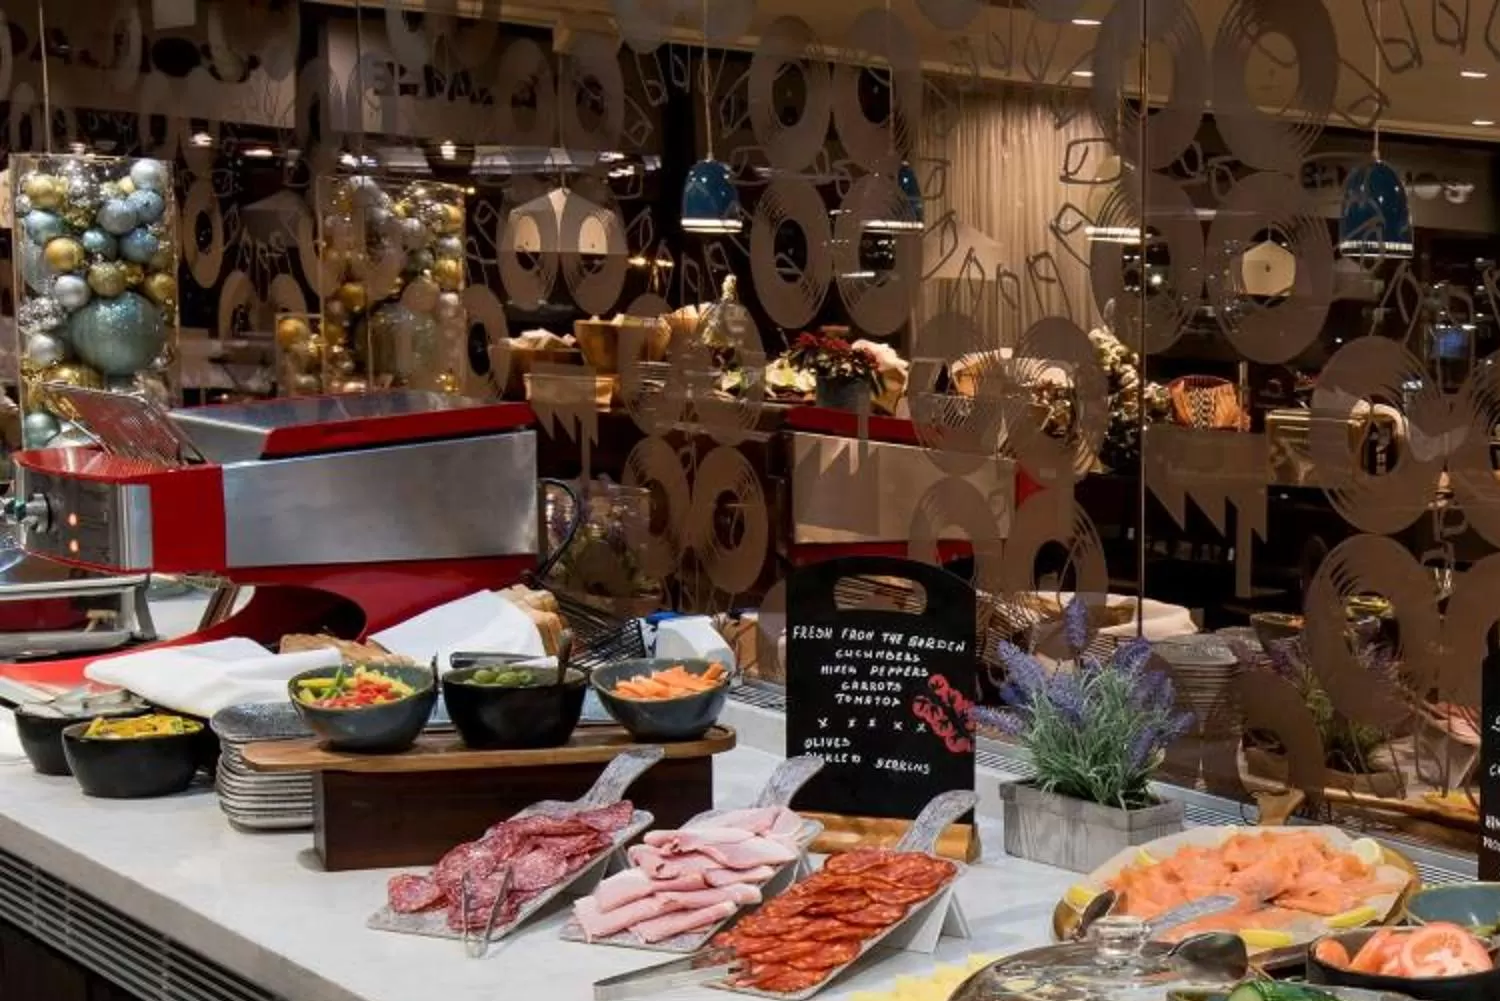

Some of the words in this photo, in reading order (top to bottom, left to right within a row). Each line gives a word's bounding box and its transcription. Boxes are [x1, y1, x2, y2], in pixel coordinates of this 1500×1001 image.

[792, 625, 833, 640] FRESH
[841, 627, 875, 641] FROM
[881, 631, 905, 645] THE
[907, 635, 967, 653] GARDEN
[835, 648, 921, 663] CUCUMBERS
[869, 665, 929, 678] PEPPERS
[841, 680, 903, 693] CARROTS
[803, 737, 852, 749] OLIVES
